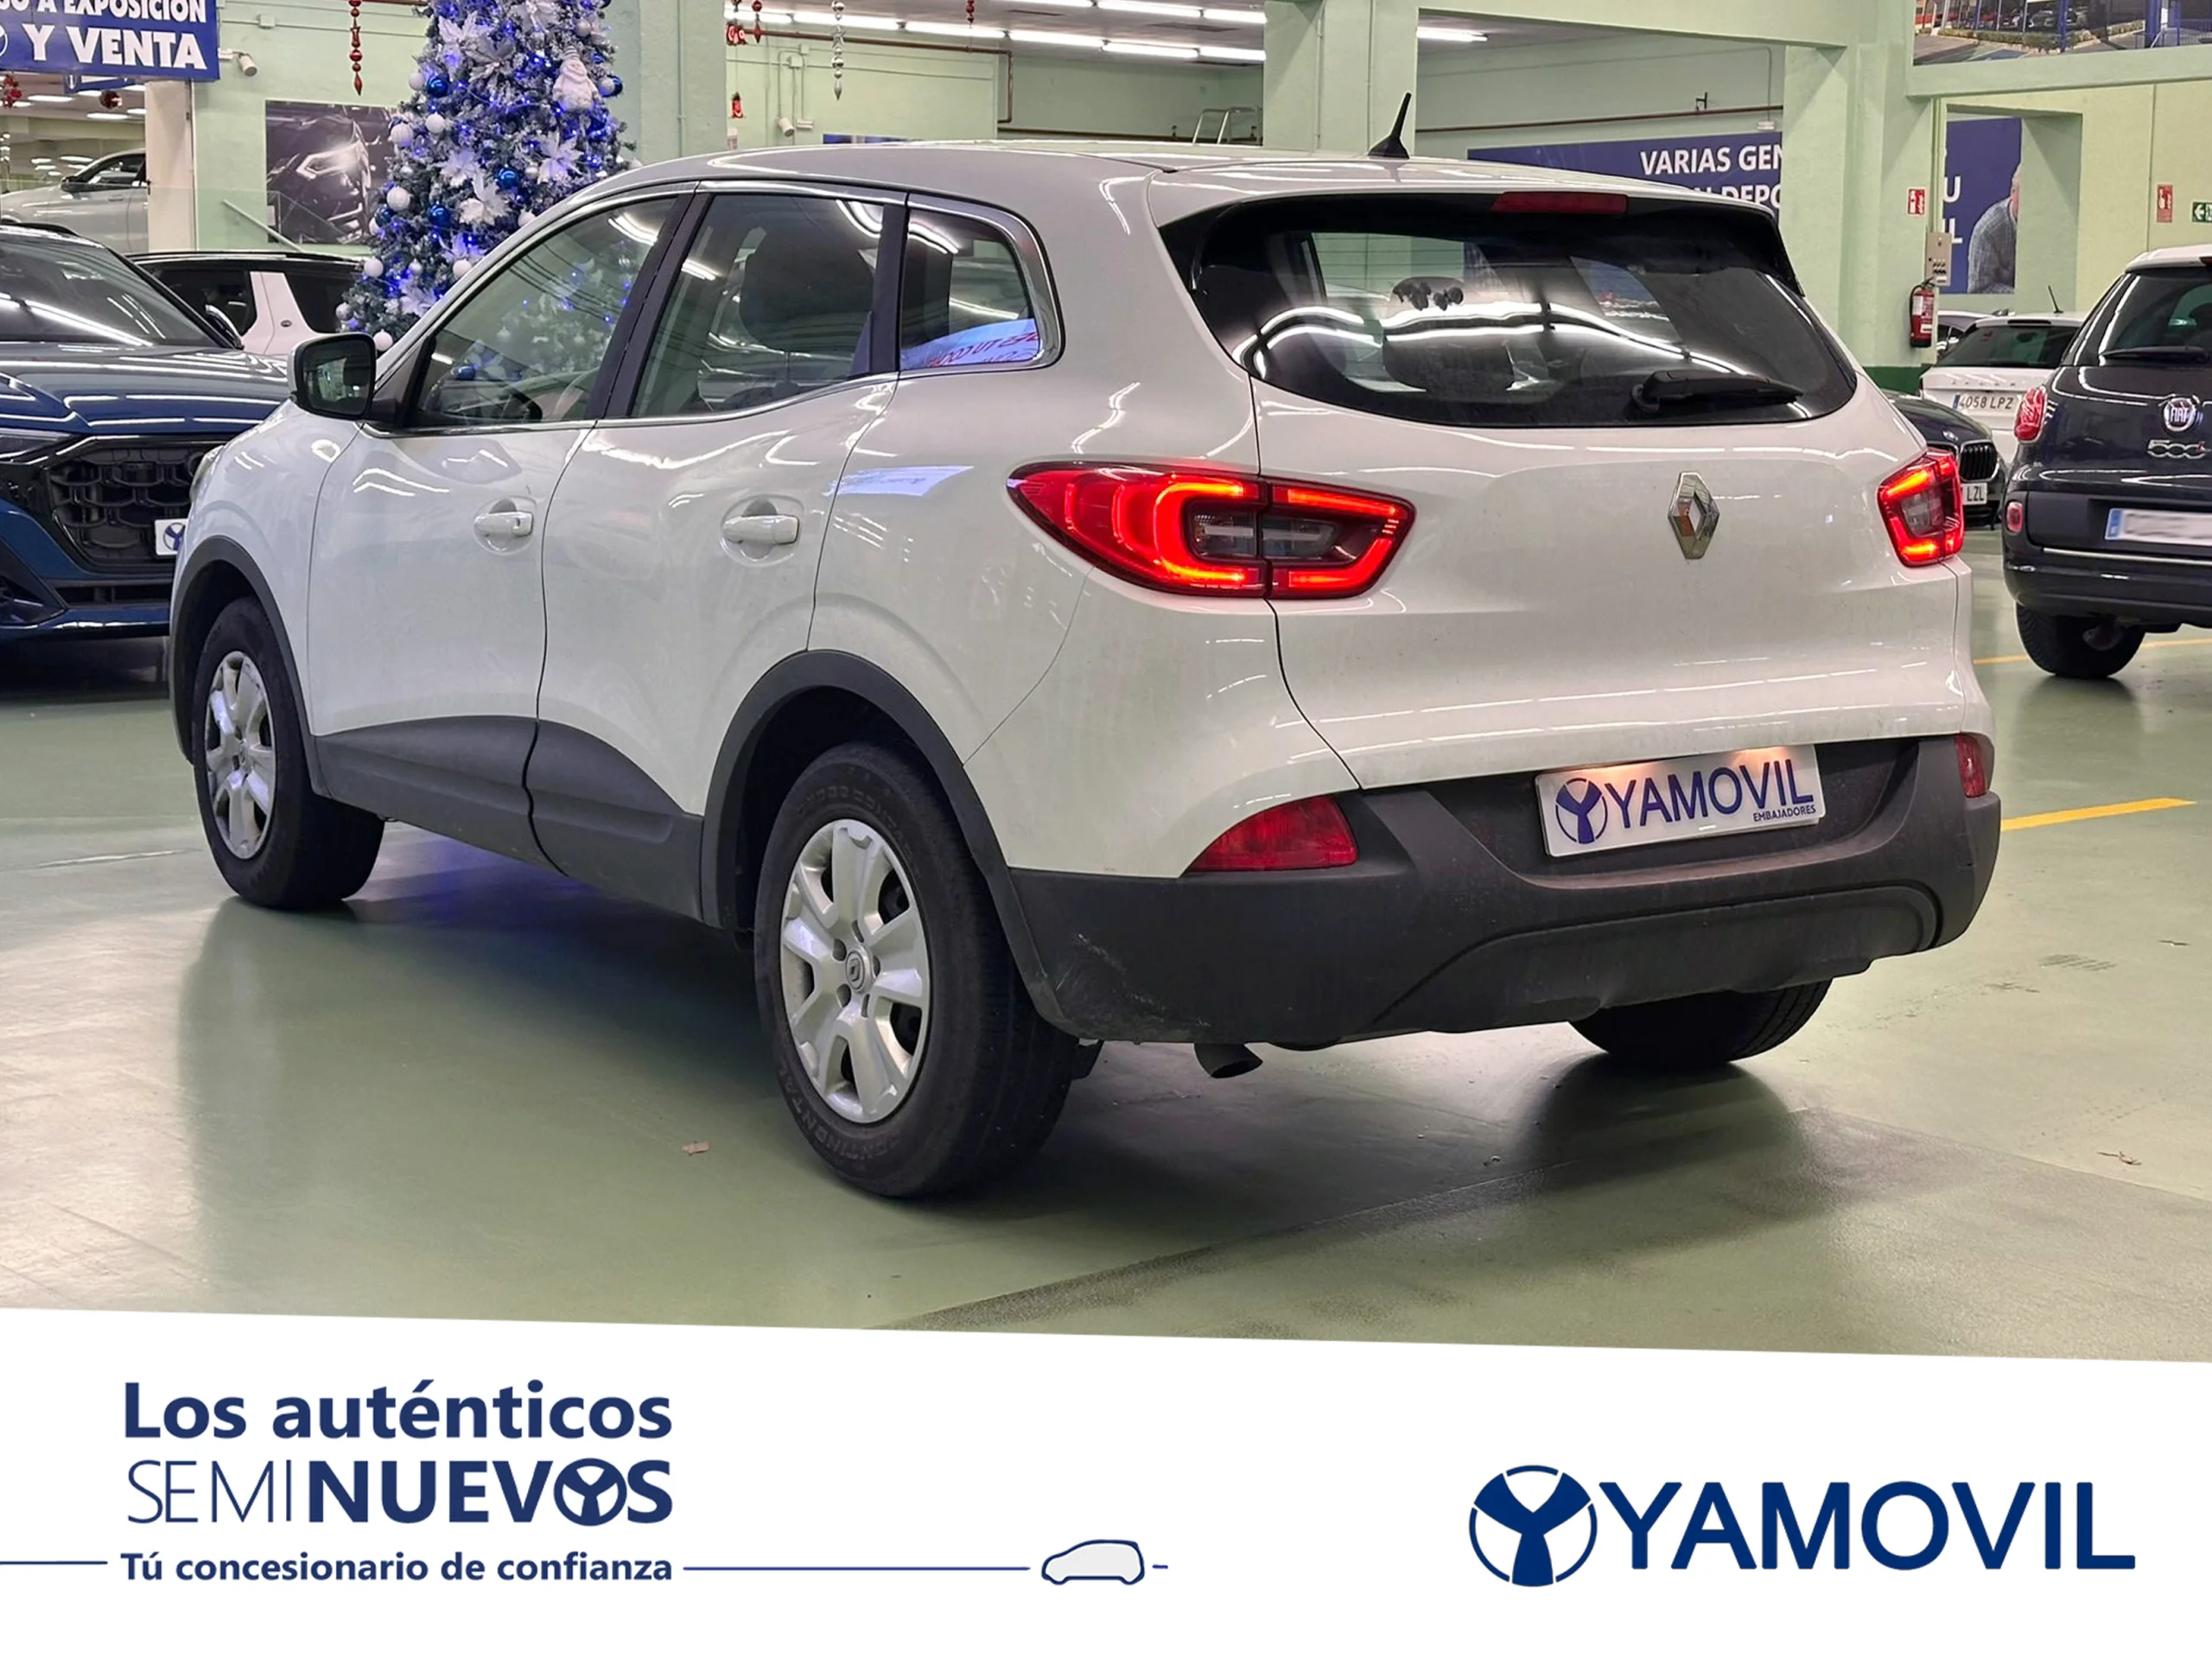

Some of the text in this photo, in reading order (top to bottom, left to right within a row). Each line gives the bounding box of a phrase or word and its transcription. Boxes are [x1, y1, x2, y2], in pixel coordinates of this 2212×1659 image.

[22, 23, 208, 71] Y VENTA
[1640, 146, 1732, 175] VARIAS
[1959, 395, 2014, 410] 4058 LPZ
[1966, 485, 1985, 502] LZL
[1605, 759, 1814, 829] YAMOVIL
[1753, 804, 1817, 823] EMBAJADORES
